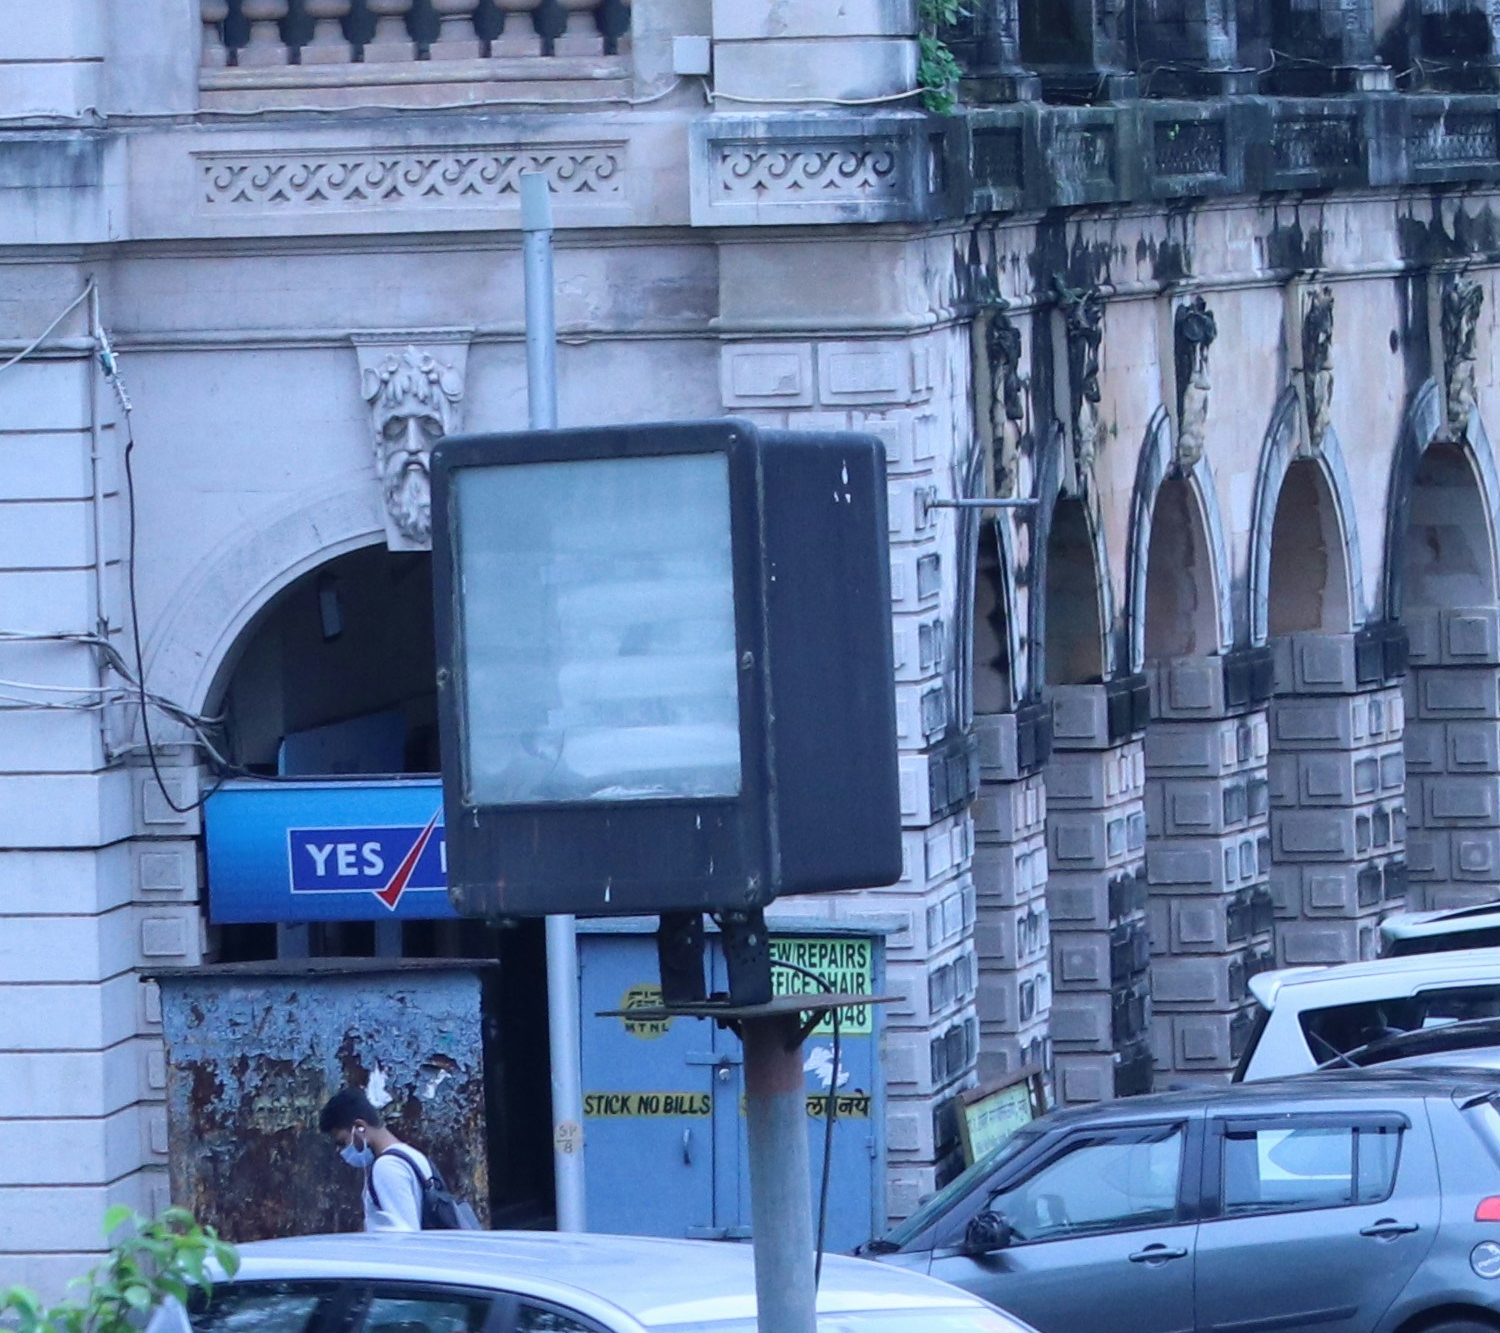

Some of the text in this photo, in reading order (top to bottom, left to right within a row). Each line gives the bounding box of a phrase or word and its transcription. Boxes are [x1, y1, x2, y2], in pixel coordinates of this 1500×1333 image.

[306, 842, 385, 877] YES
[768, 943, 867, 969] EW/REPAIRS
[771, 971, 866, 995] FICE CHAIR
[584, 1094, 711, 1115] STICK NO BILLS
